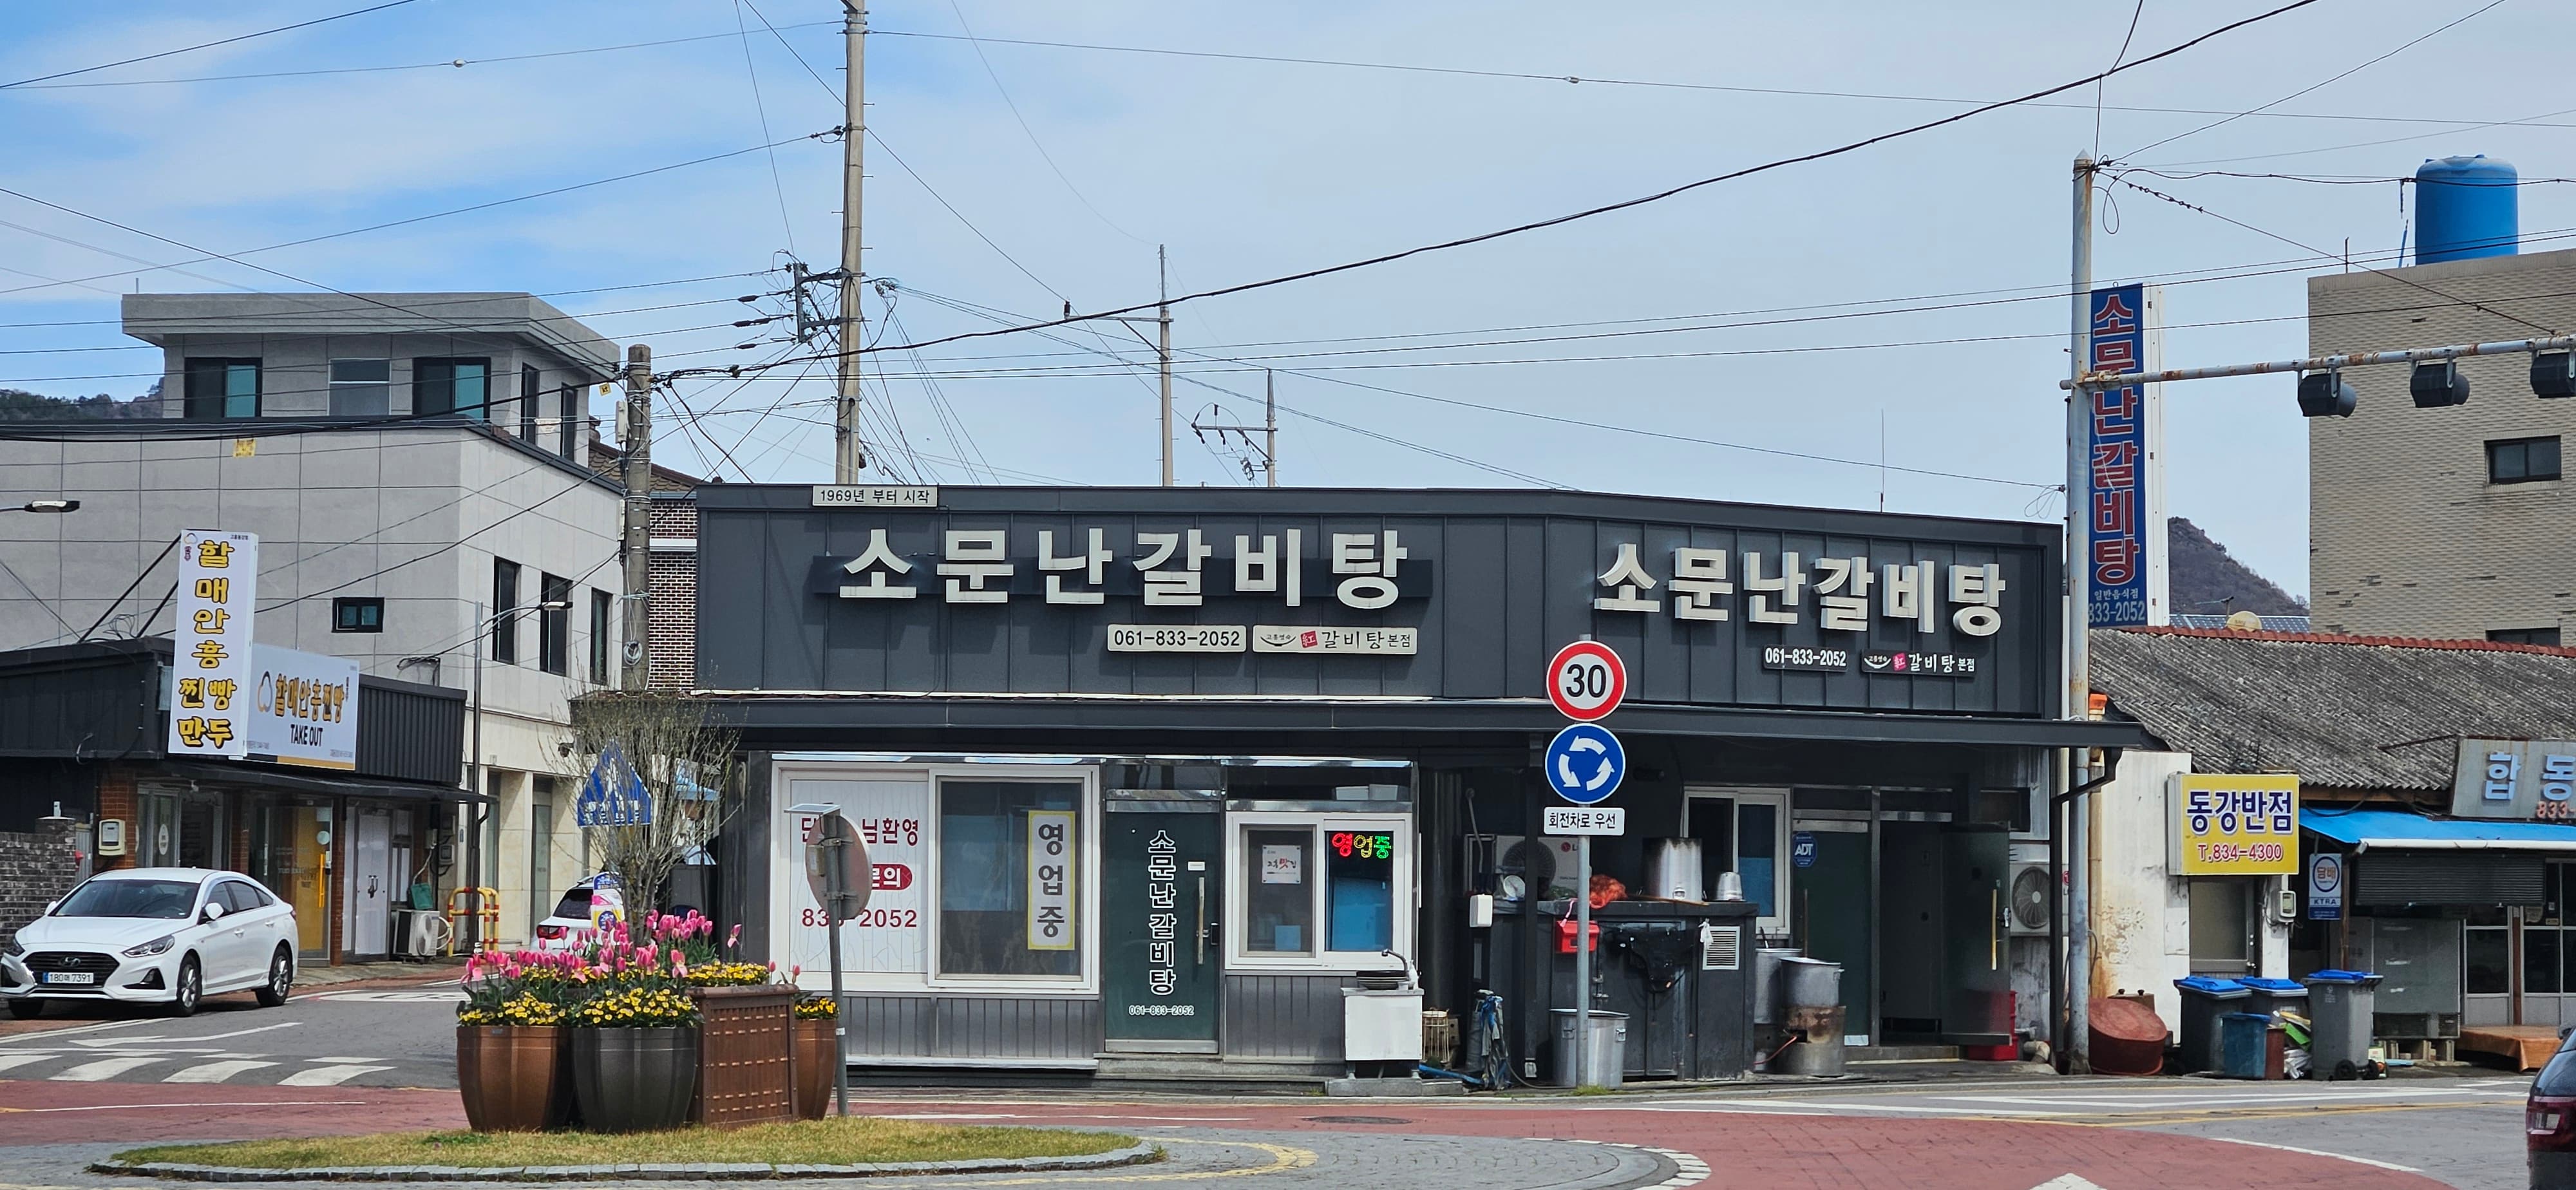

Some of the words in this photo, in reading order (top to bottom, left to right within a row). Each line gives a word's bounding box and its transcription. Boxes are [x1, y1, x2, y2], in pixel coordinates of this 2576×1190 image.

[820, 489, 865, 503] 1969년
[872, 489, 898, 504] 부터
[904, 489, 930, 504] 시작
[839, 527, 1408, 610] 소문난갈비탕
[1594, 543, 2006, 636] 소문난갈비탕
[2094, 588, 2138, 601] 일반음식점
[193, 540, 235, 668] 할매안흥
[1113, 630, 1240, 647] 061-833-2052
[1321, 631, 1385, 649] 갈비탕
[1387, 634, 1411, 648] 본점
[1765, 647, 1846, 666] 061-833-2052
[1908, 654, 1955, 673] 갈비탕
[1958, 657, 1975, 672] 본점
[1566, 664, 1607, 698] 30
[179, 677, 237, 710] 찐빵
[275, 673, 345, 724] 할매안흥찐빵
[177, 716, 234, 748] 만두
[290, 724, 308, 744] TAKE
[309, 726, 323, 747] OUT
[1548, 812, 1591, 829] 회전차로
[1595, 813, 1616, 830] 우선
[2187, 791, 2292, 833] 동강반점
[1331, 832, 1392, 860] 영업중
[1794, 844, 1814, 856] ADT
[2197, 844, 2282, 862] T.834-4300
[1037, 824, 1065, 938] 영업중
[2317, 866, 2336, 880] 담배
[1148, 829, 1177, 996] 소문난갈비탕
[72, 974, 91, 982] 7391
[1128, 1005, 1195, 1016] 061-833-2052
